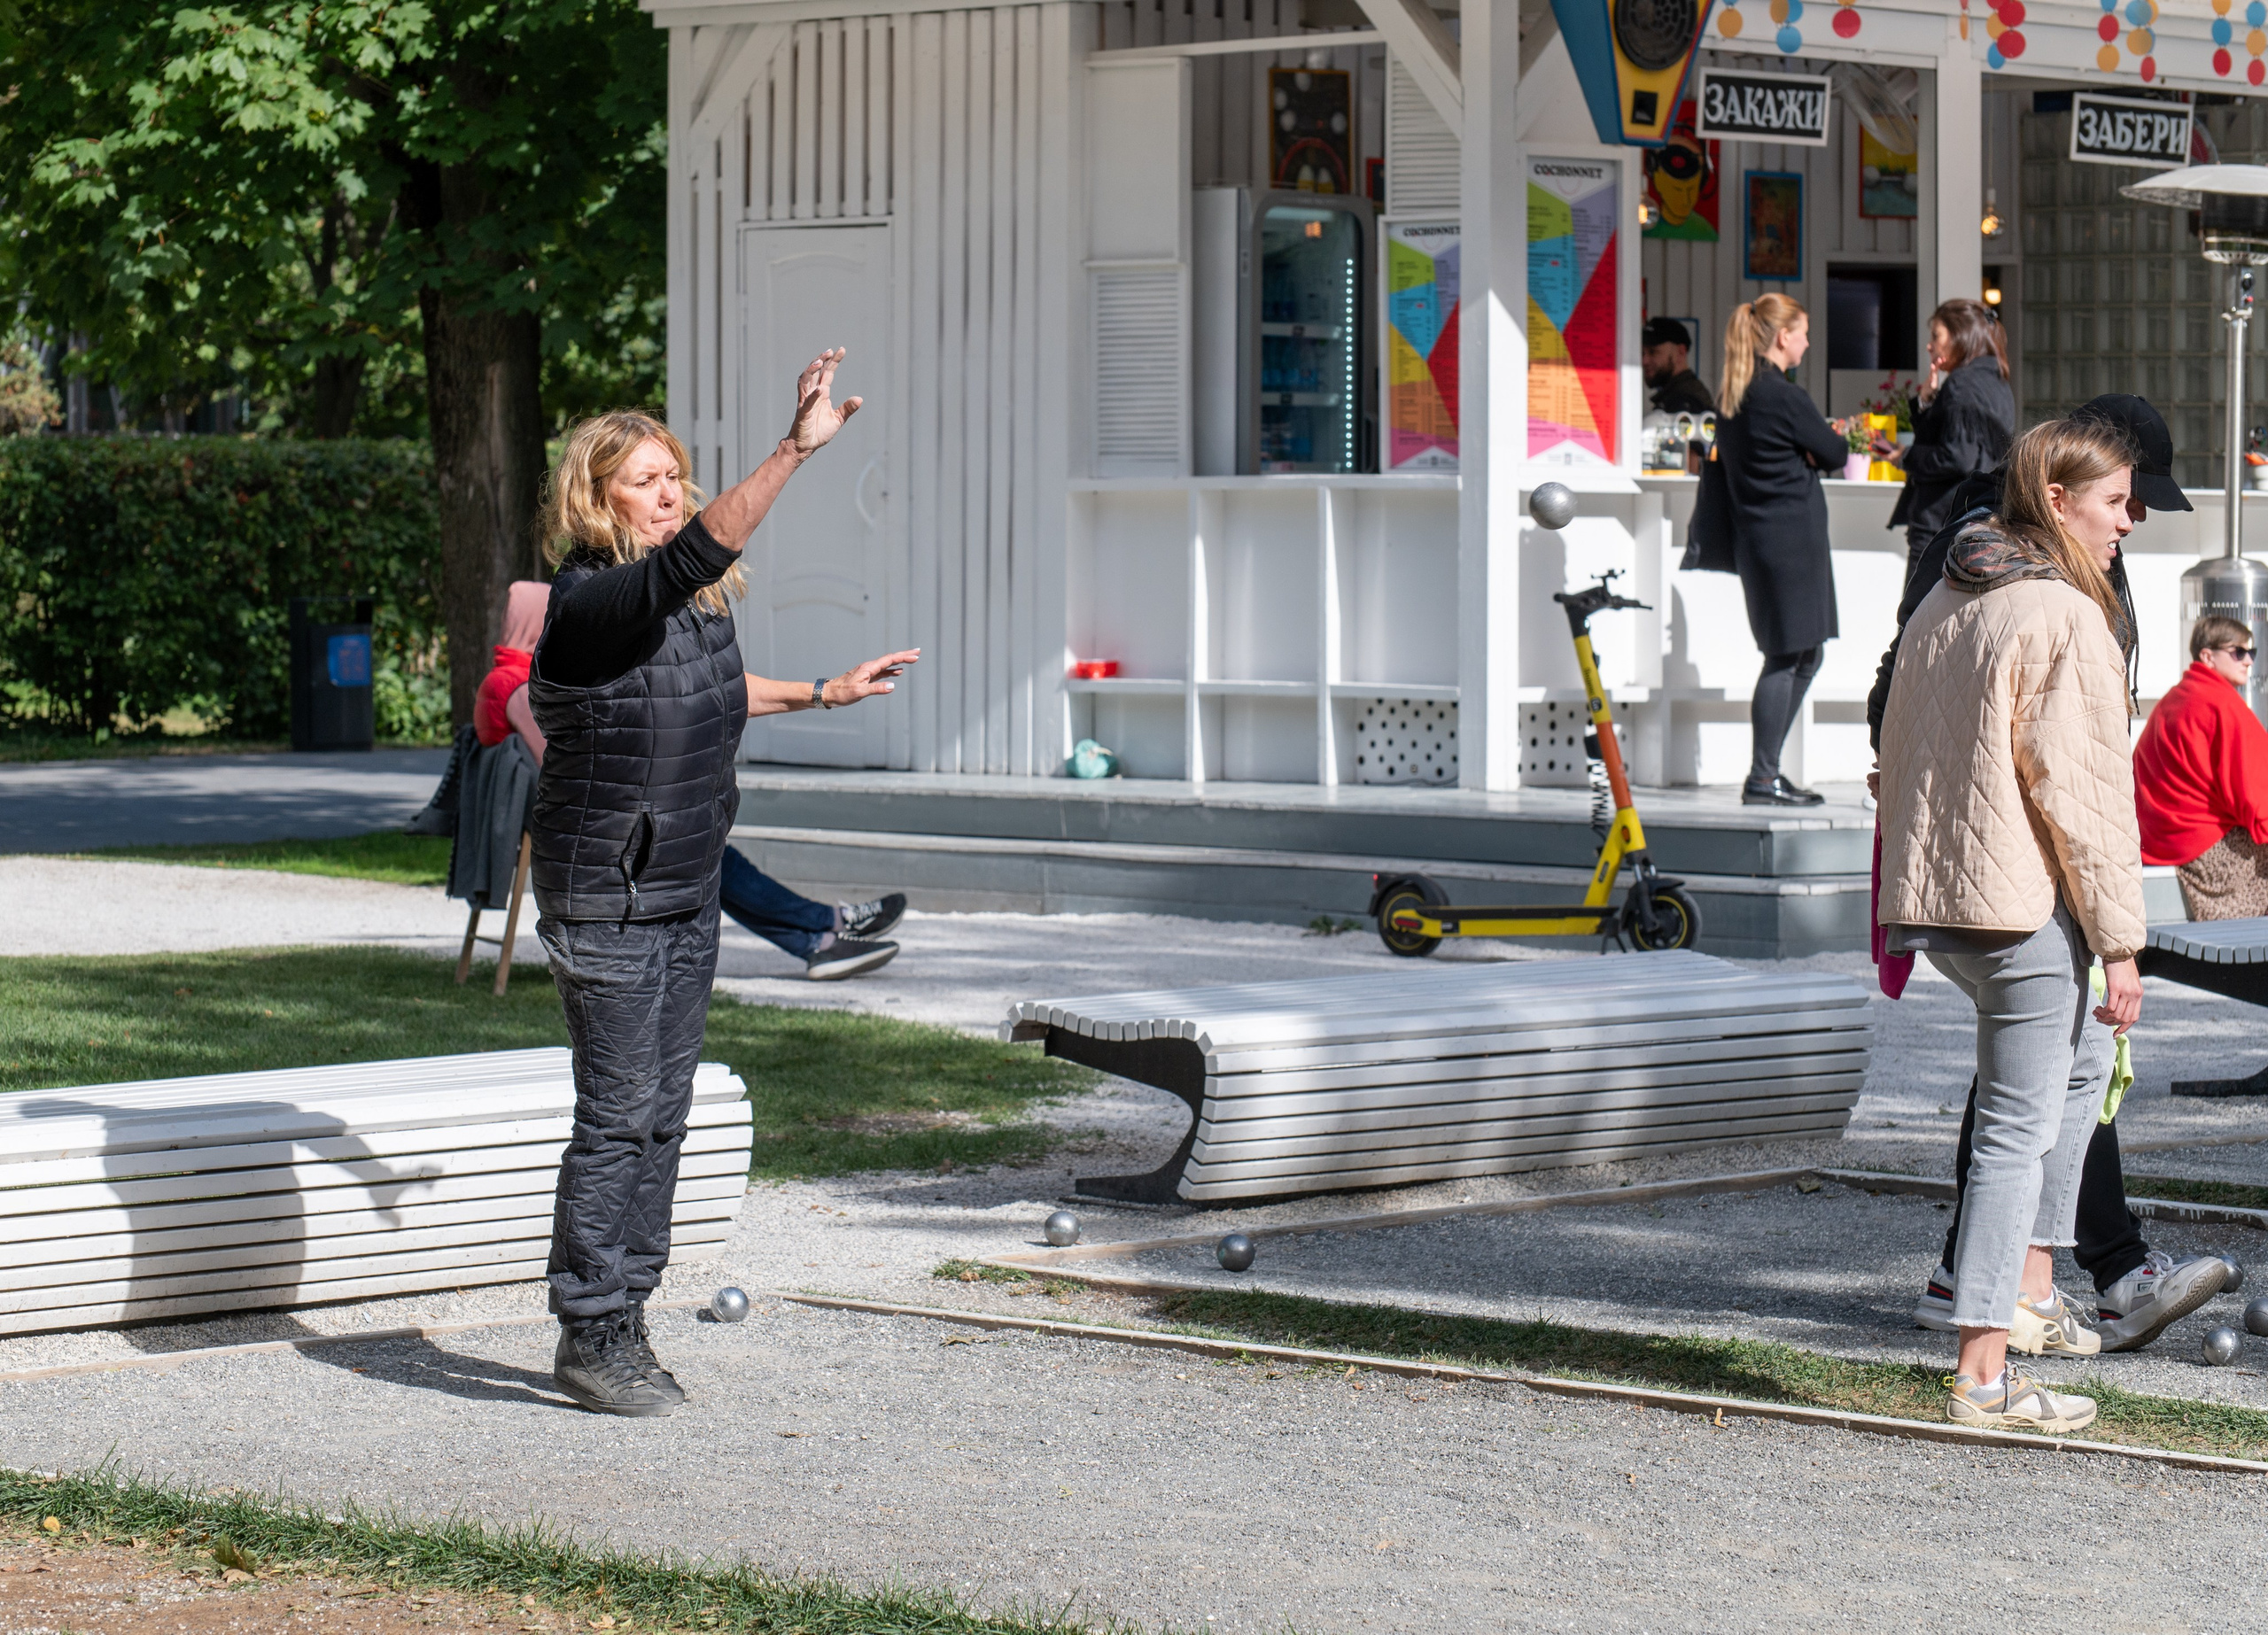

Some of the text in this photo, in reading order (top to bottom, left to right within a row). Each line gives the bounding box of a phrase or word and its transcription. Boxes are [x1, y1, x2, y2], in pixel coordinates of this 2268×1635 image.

[1705, 82, 1825, 130] ЗАКАЖИ
[2078, 107, 2187, 155] ЗАБЕРИ
[1534, 163, 1603, 179] COCHONNET
